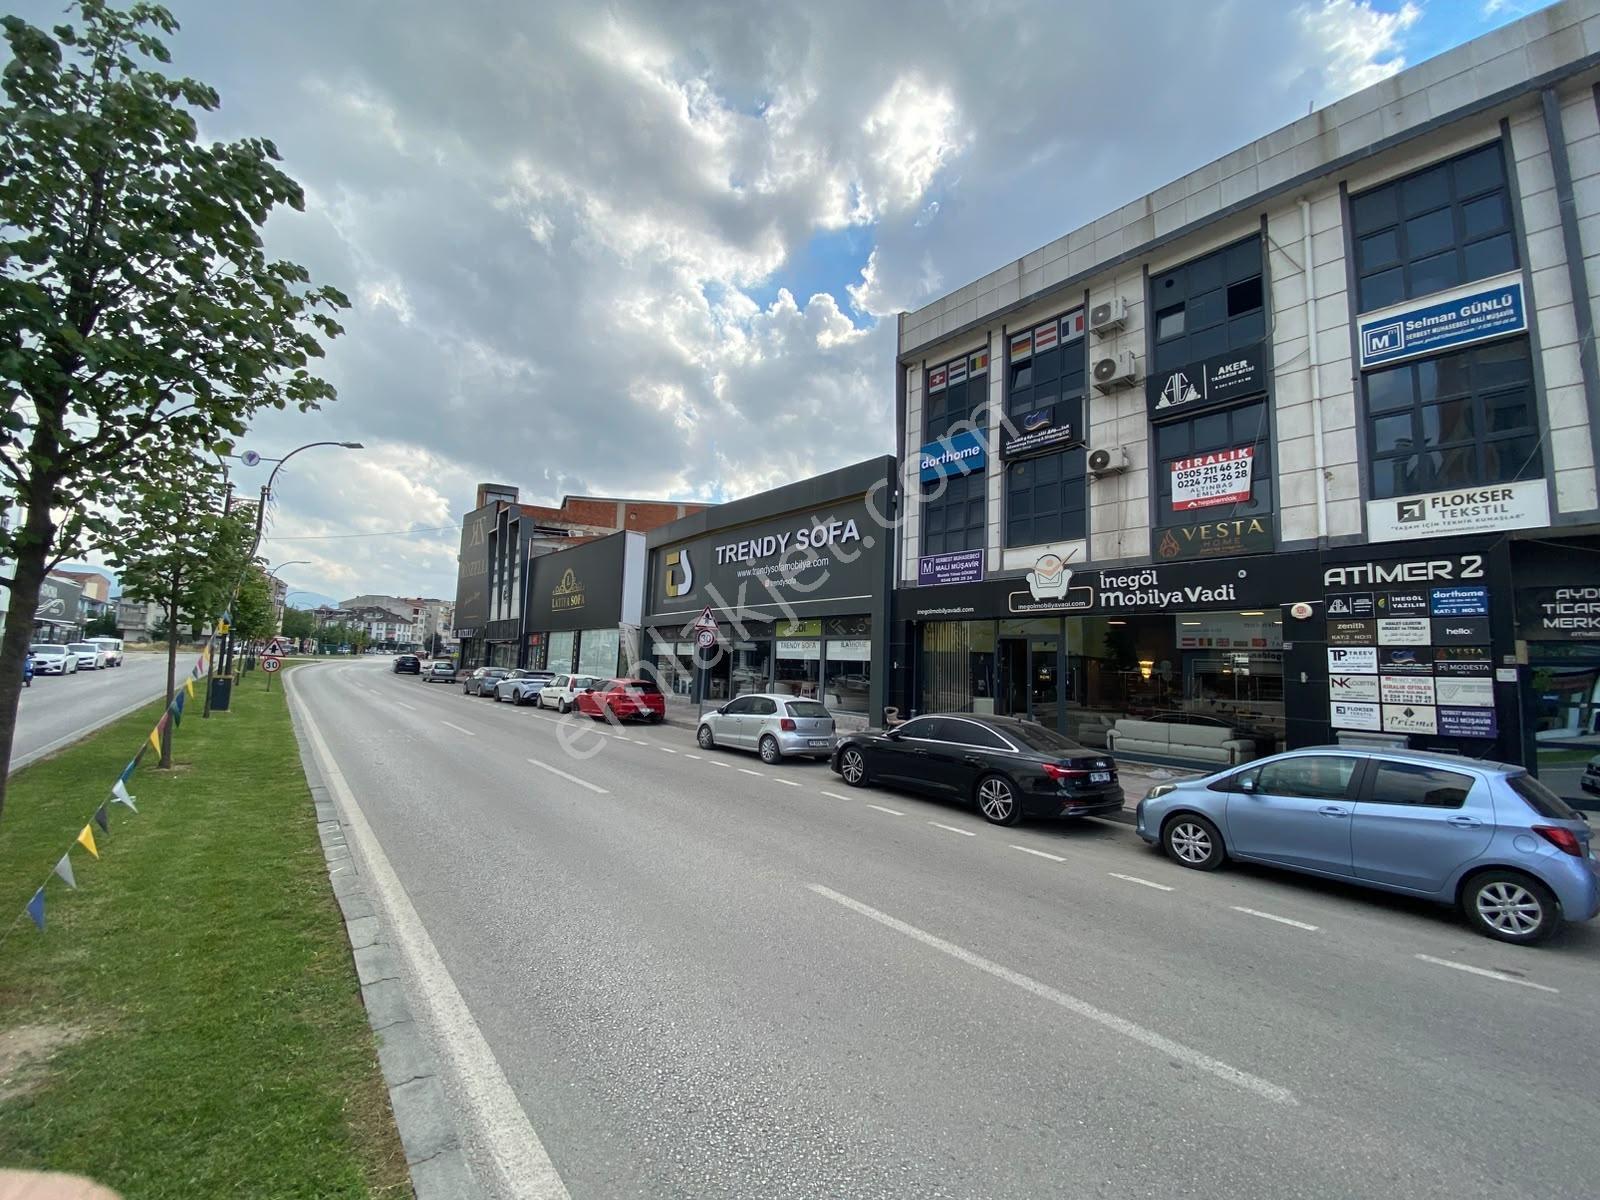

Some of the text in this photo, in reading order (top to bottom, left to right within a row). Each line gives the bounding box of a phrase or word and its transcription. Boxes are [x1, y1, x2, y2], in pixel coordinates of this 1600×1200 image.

[1406, 311, 1457, 331] Selman
[1460, 294, 1513, 317] GÜNLÜ
[1218, 360, 1247, 375] AKER
[921, 444, 980, 470] dorthome
[1177, 460, 1247, 480] 0505 211 46 20
[1177, 470, 1247, 488] 0224 715 26 28
[1431, 489, 1514, 508] FLOKSER
[1439, 504, 1509, 519] TEKSTİL
[1181, 519, 1264, 541] VESTA
[715, 520, 861, 565] TRENDY SOFA
[736, 557, 829, 578] www.trendysofamobilya.com
[1460, 555, 1483, 578] 2
[1184, 584, 1235, 603] Vadi
[1433, 590, 1484, 598] dorthome
[1337, 622, 1364, 630] zenith
[700, 634, 711, 644] 30
